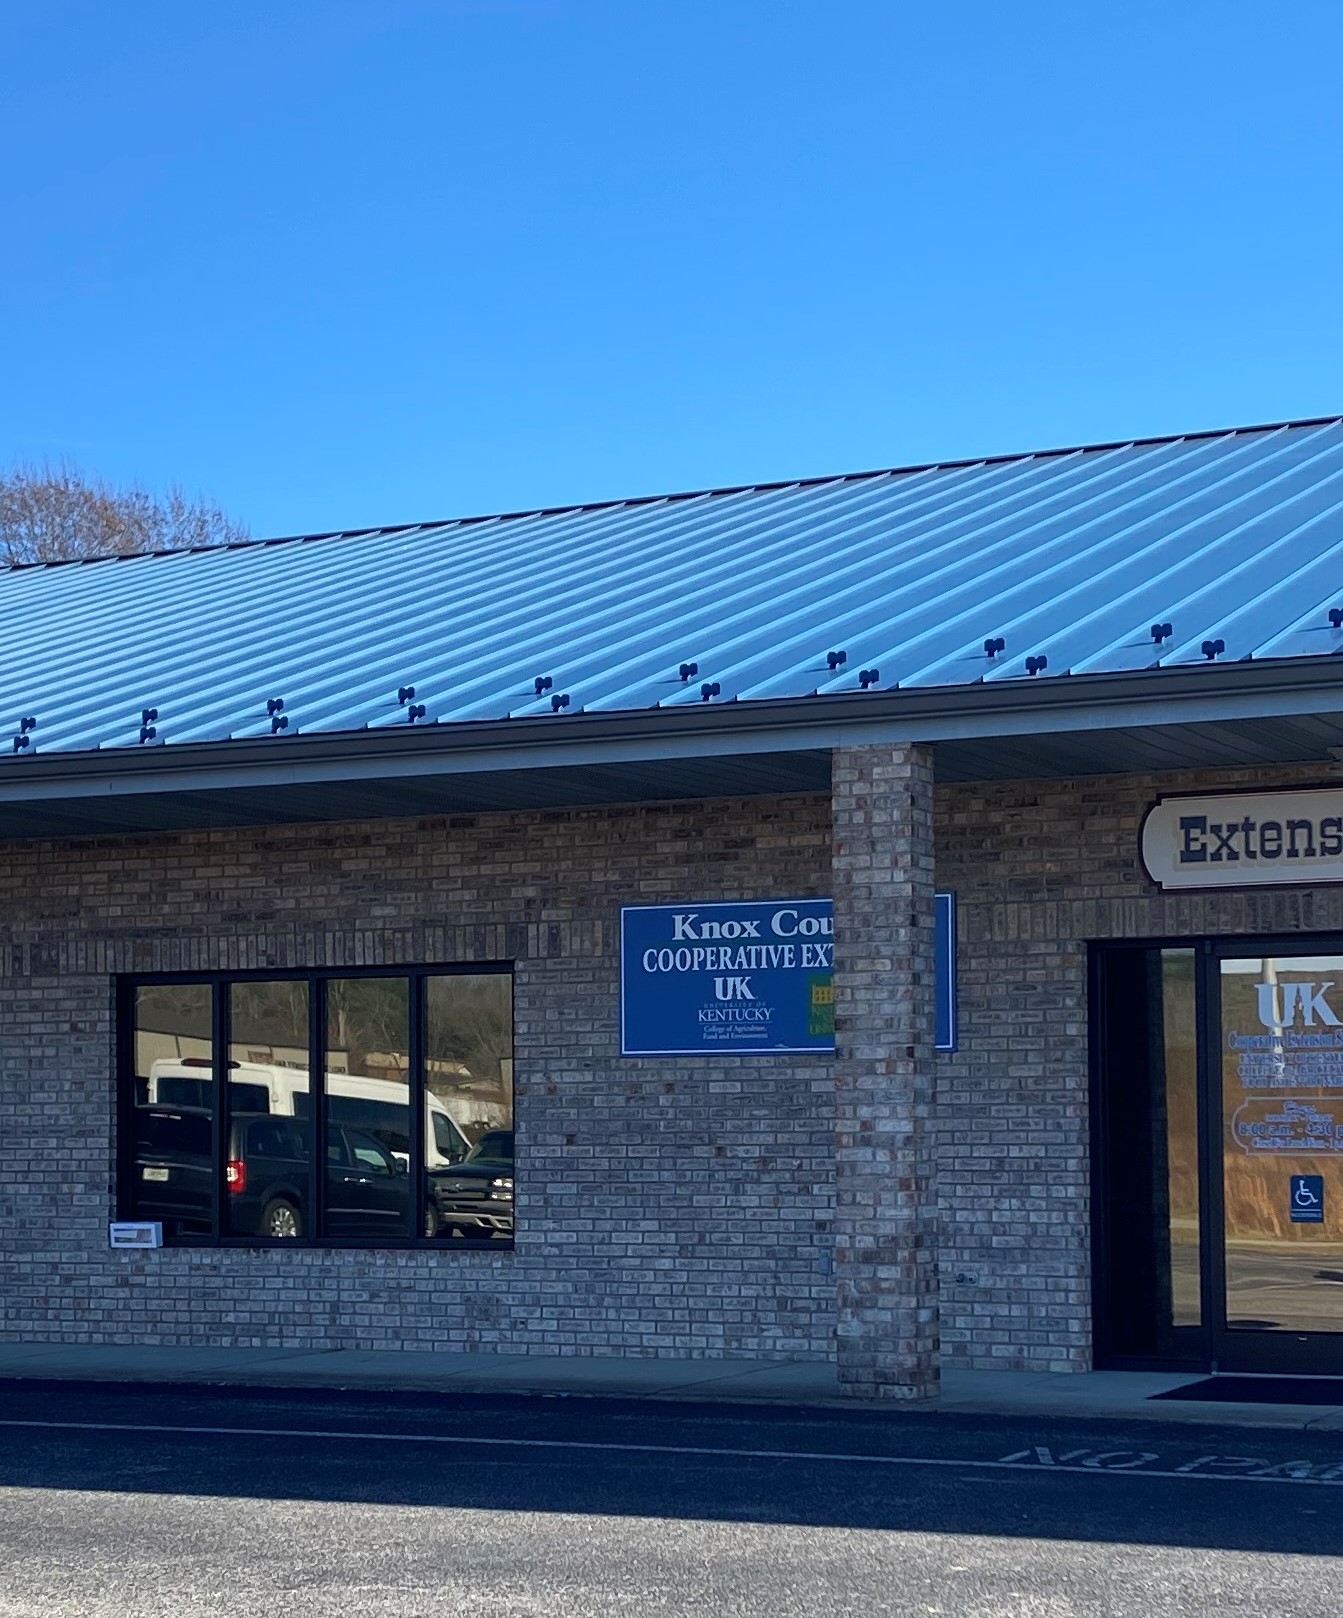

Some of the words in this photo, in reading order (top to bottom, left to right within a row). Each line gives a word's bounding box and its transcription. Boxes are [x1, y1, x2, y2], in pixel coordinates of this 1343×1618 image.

[671, 912, 761, 941] Knox
[642, 944, 796, 972] COOPERATIVE
[713, 976, 757, 1001] UK
[698, 1007, 772, 1022] KENTUCKY
[998, 1446, 1159, 1468] NO
